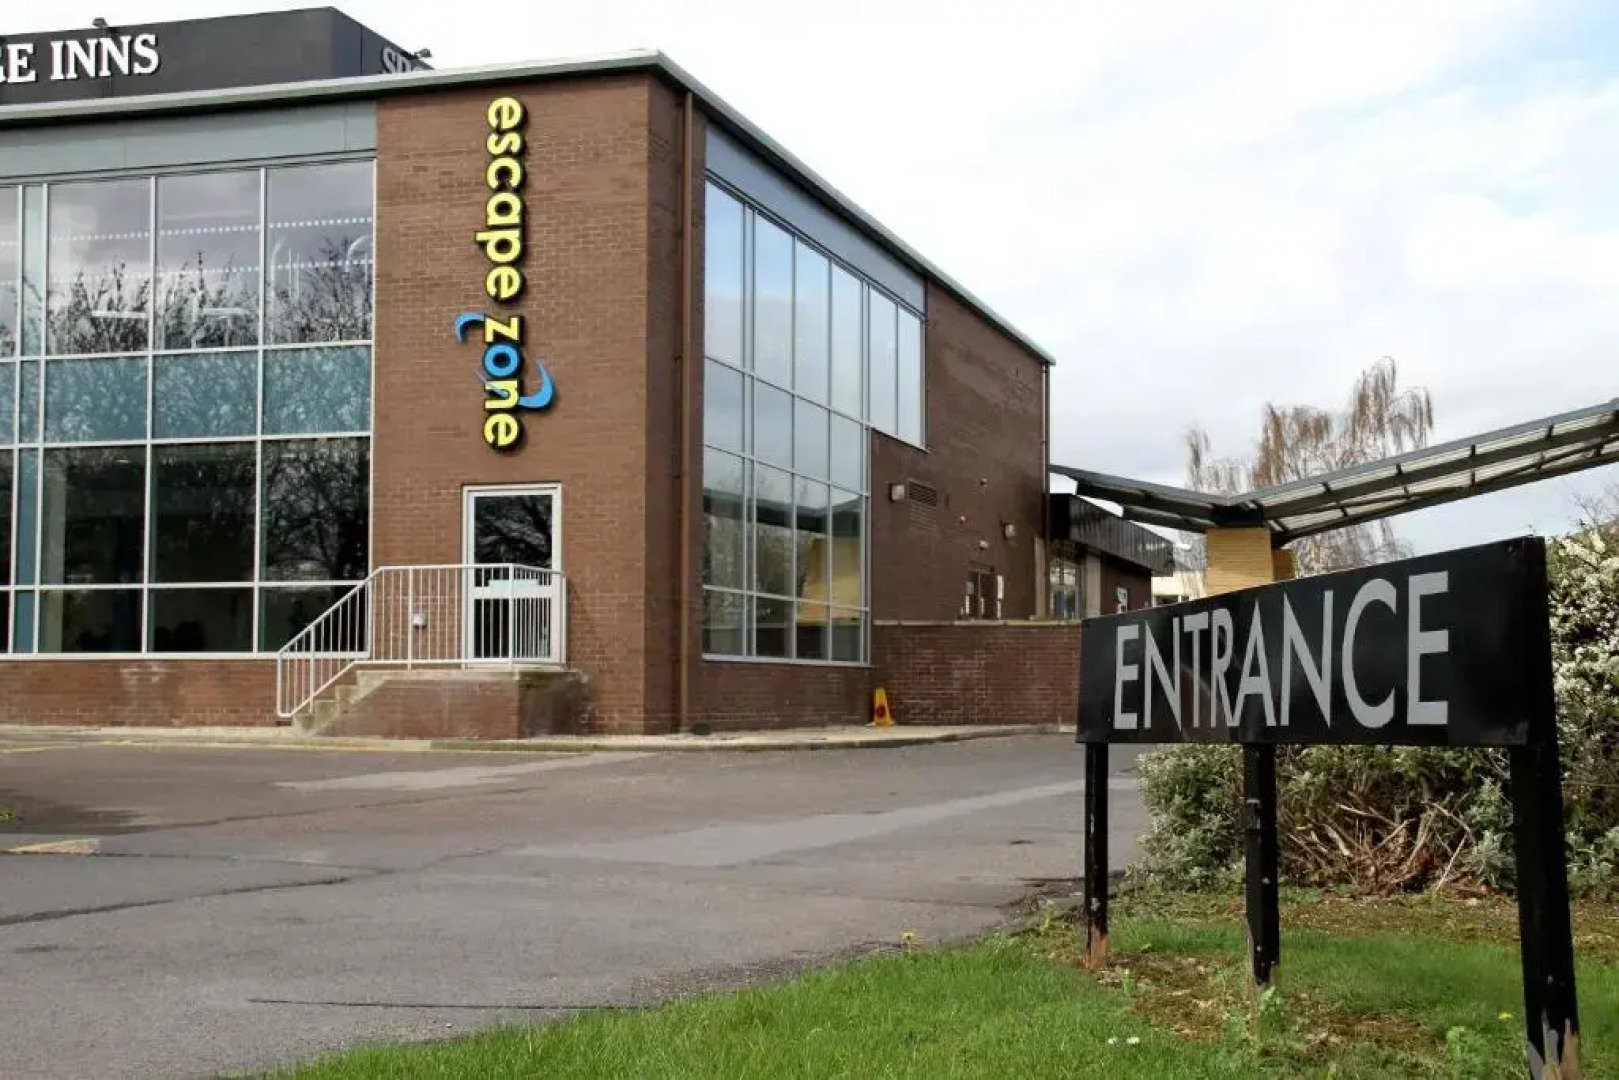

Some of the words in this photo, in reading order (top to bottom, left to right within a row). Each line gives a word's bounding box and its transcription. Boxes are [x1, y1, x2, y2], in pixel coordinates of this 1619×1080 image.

[0, 44, 36, 82] E
[50, 34, 158, 80] INNS
[475, 96, 523, 301] escape
[482, 316, 521, 448] zone
[1112, 570, 1449, 732] ENTRANCE
